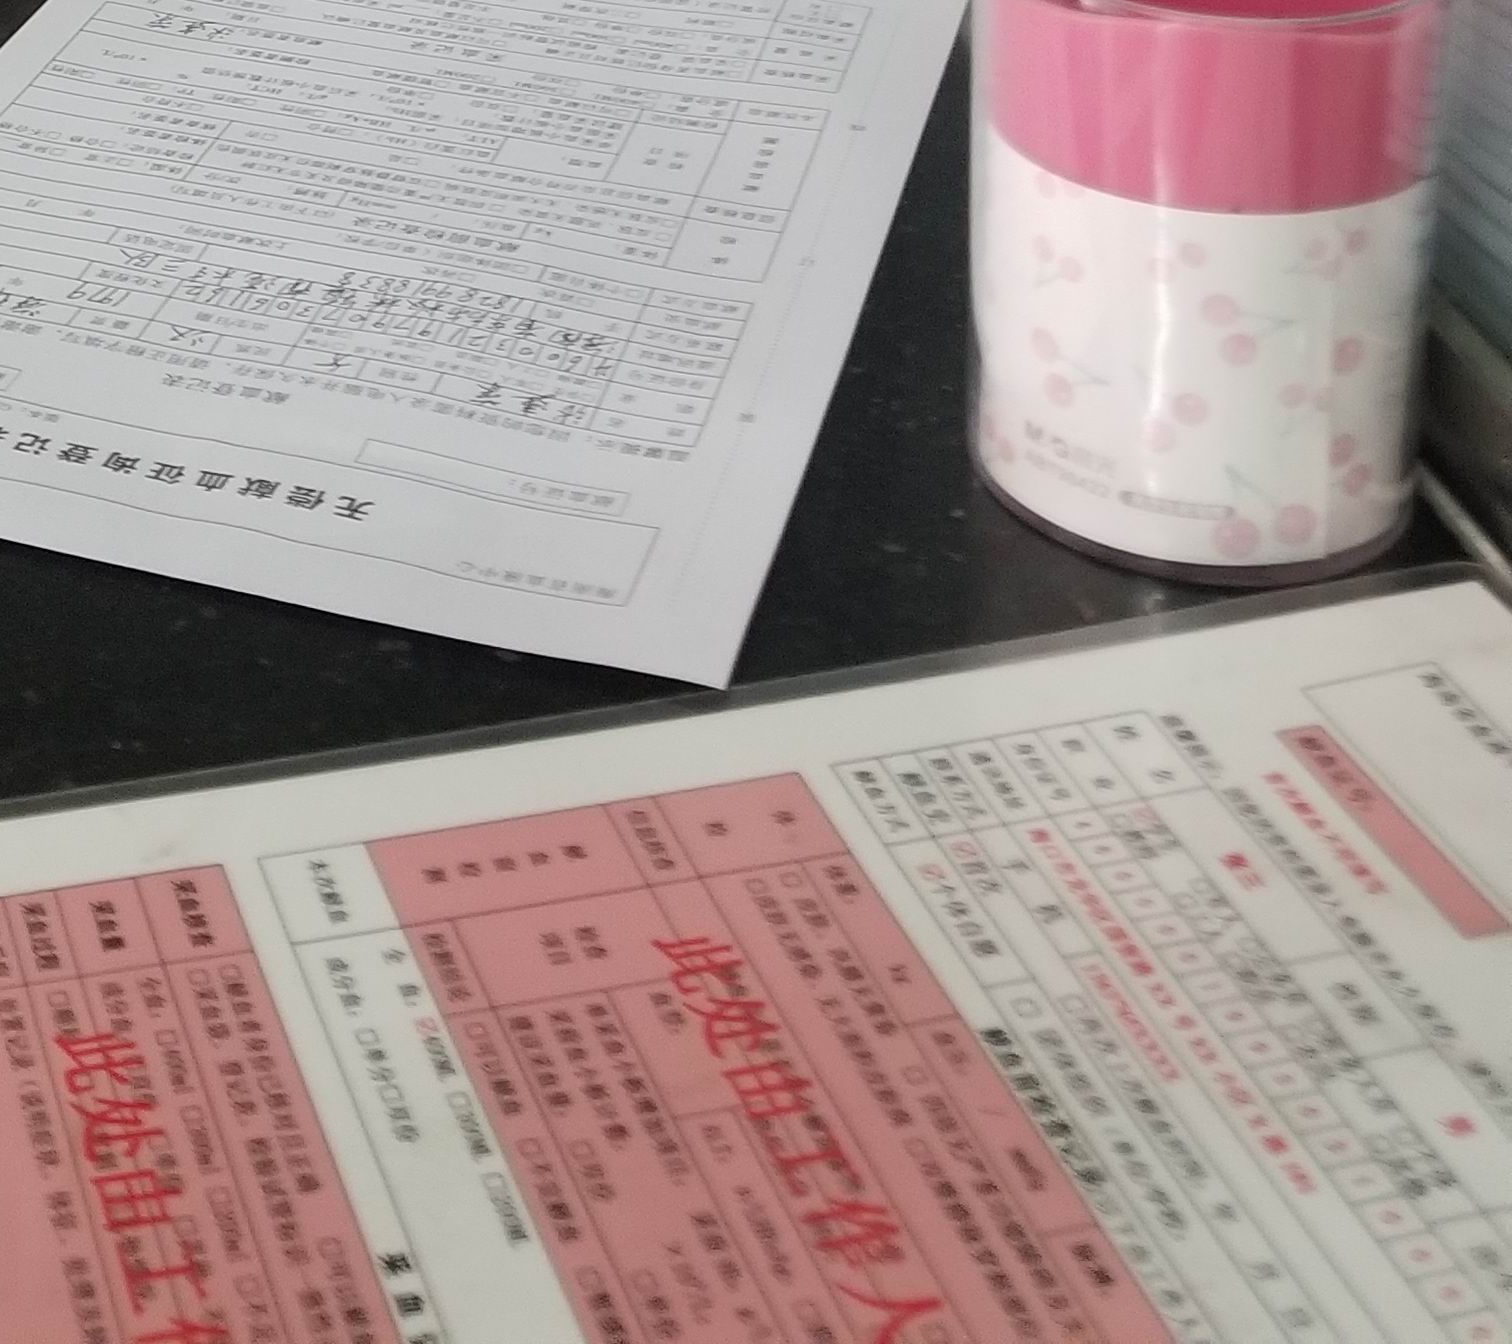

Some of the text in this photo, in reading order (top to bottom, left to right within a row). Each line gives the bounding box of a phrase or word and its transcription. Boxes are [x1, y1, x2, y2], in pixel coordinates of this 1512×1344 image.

[649, 927, 960, 1344] 此处由工作人
